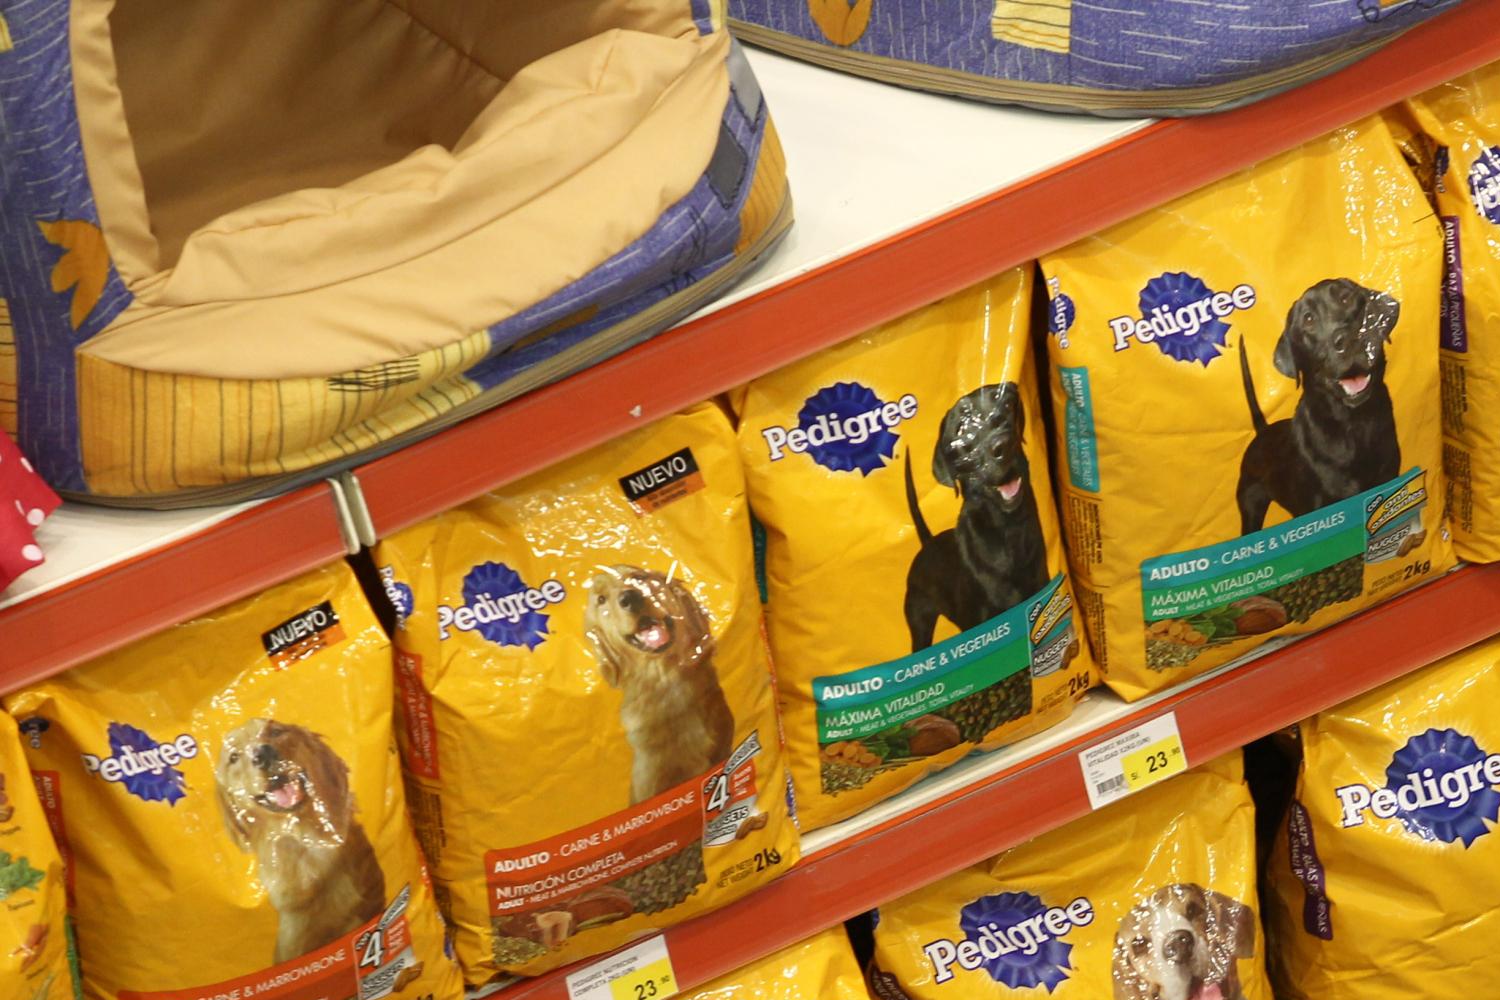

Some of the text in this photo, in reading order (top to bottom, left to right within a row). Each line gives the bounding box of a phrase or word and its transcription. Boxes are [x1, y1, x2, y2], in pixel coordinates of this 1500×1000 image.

[1445, 221, 1455, 267] ADULTO
[1110, 284, 1256, 351] Pedigree
[762, 394, 918, 461] Pedigree
[628, 457, 688, 494] NUEVO
[1149, 511, 1345, 581] ADULTO CARNE VEGETALES
[1151, 565, 1275, 607] MÁXIMA VITALIDAD
[1404, 561, 1430, 580] 2kg
[268, 610, 327, 650] NUEVO
[438, 579, 566, 640] Pedigree
[1152, 606, 1179, 616] ADULT
[822, 623, 1010, 700] ADULTO CARNE VEGETALES
[825, 683, 945, 728] MÁXIMA VITALIDAD
[1067, 673, 1089, 696] 2kg
[826, 726, 854, 739] ADULT
[80, 733, 198, 784] Pedigree
[1145, 751, 1168, 773] 23
[706, 776, 729, 812] 4
[494, 791, 695, 874] ADULTO CARNE MARROWBONE
[496, 850, 626, 898] NUTRICIÓN COMPLETA
[754, 850, 781, 872] 2kg
[359, 928, 385, 969] 4
[924, 895, 1094, 984] Pedigree
[255, 948, 347, 996] MARROWBONE
